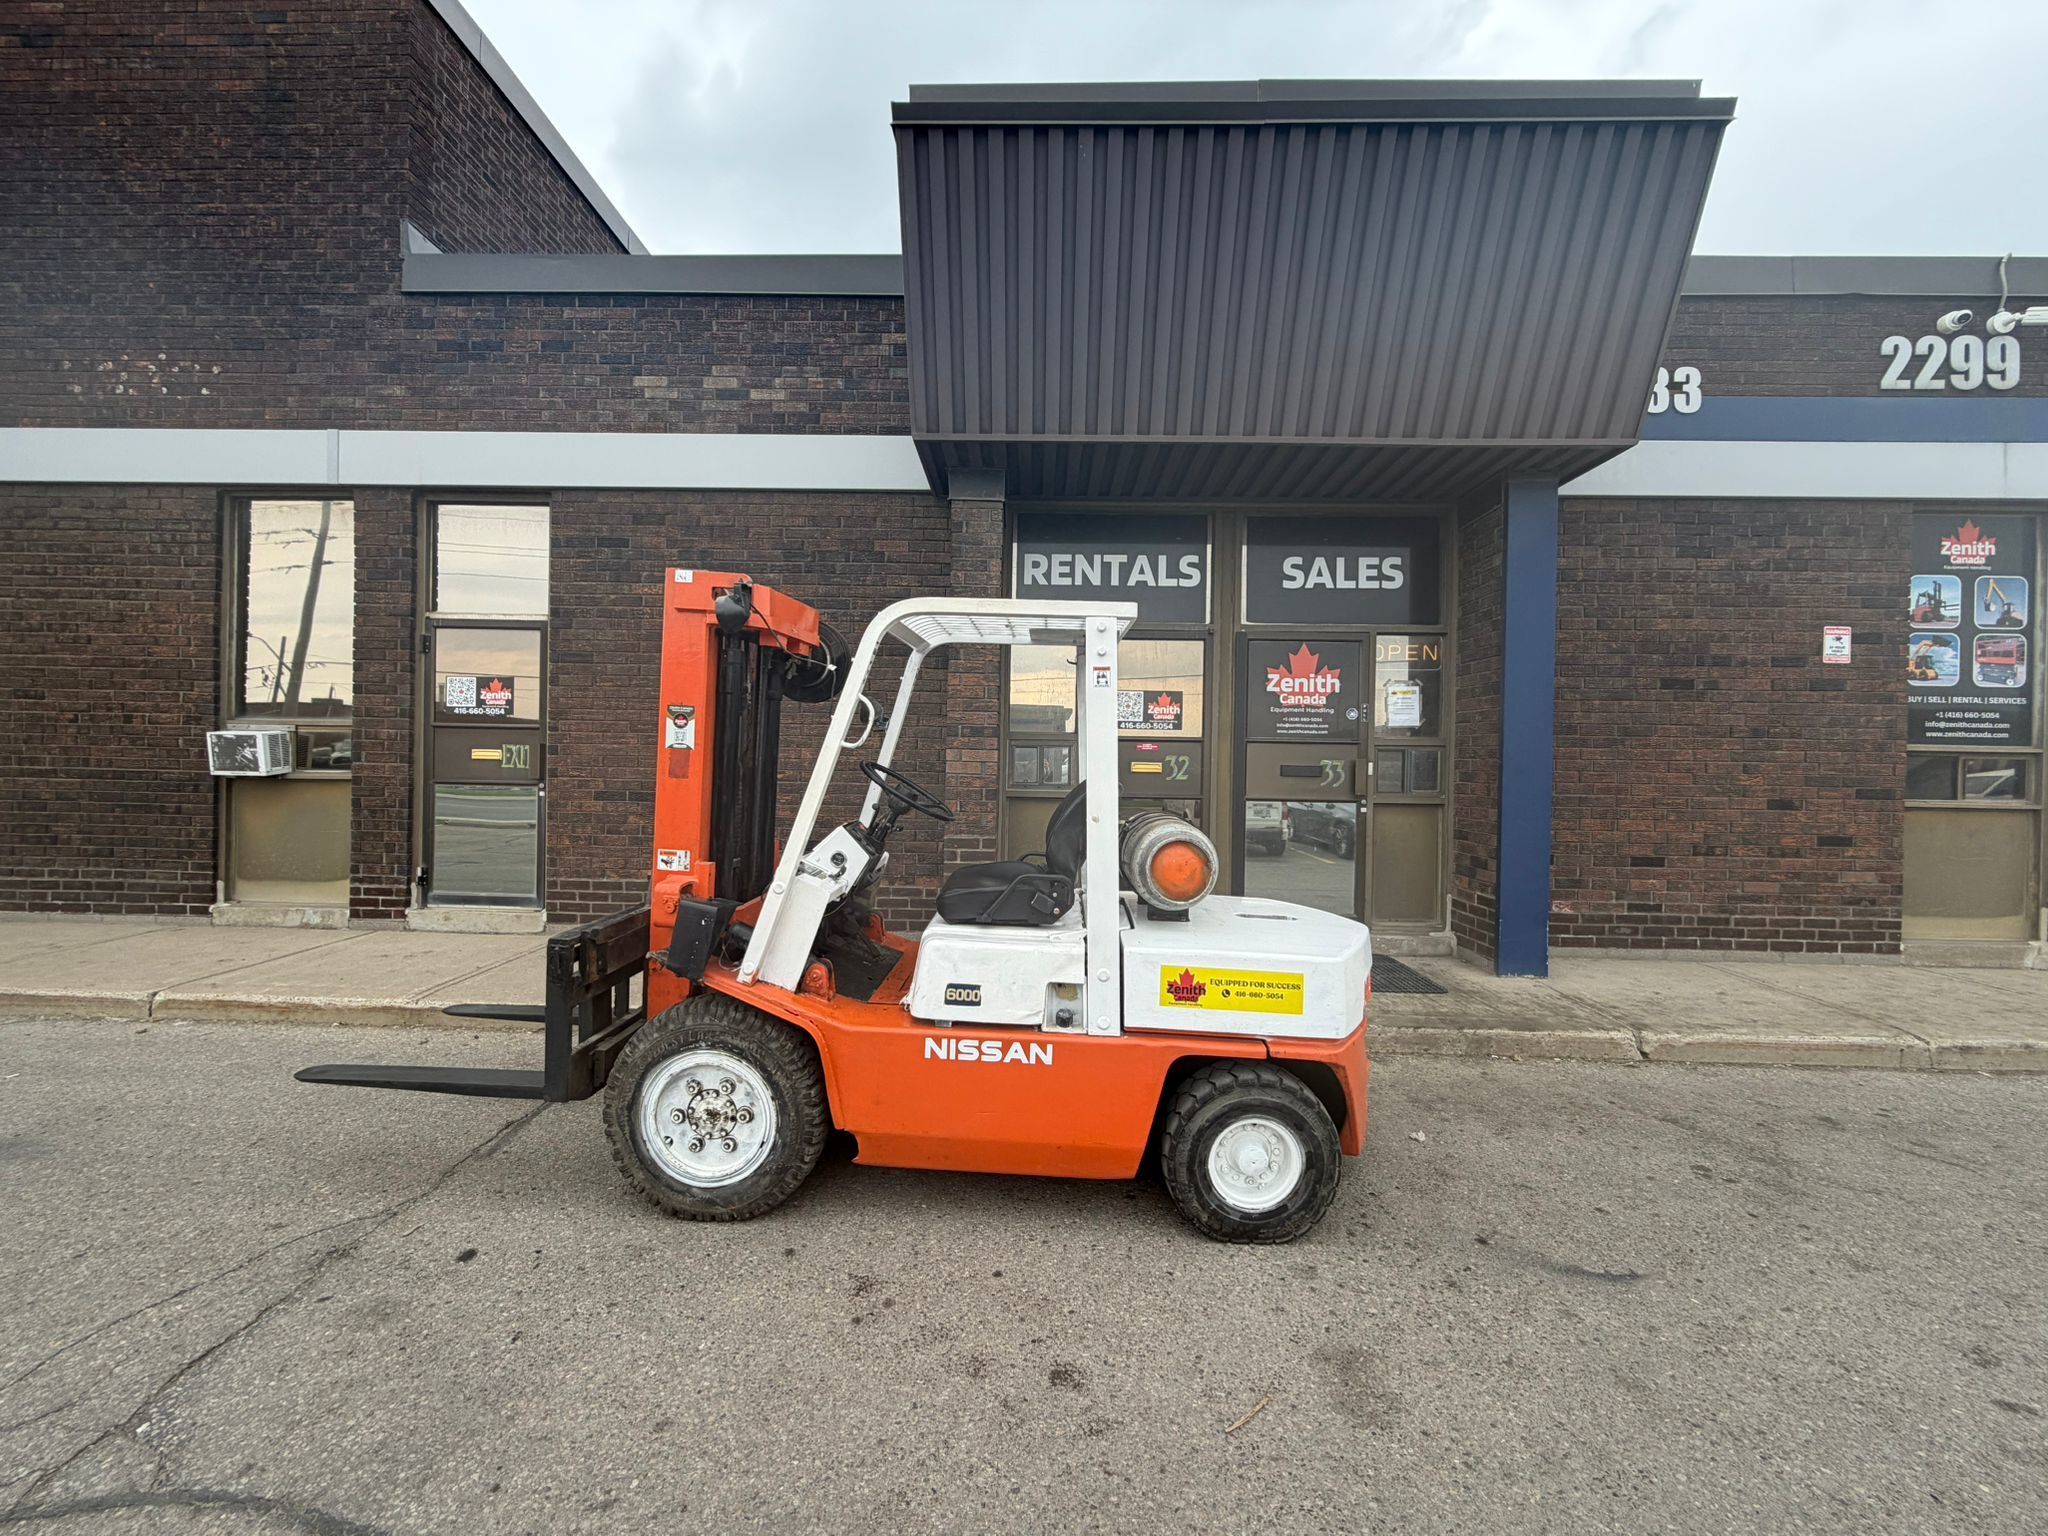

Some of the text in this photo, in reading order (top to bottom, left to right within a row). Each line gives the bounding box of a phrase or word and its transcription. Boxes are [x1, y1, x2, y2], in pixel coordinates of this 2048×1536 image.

[1880, 335, 2020, 390] 2299
[1940, 541, 1996, 555] Zenith
[1950, 555, 1986, 565] Canada
[1023, 553, 1201, 588] RENTALS
[1282, 556, 1404, 589] SALES
[1265, 673, 1341, 693] Zenith
[480, 690, 512, 700] Zenith
[1279, 693, 1327, 705] Canada
[1928, 695, 1947, 703] SELL
[1953, 696, 1983, 704] RENTAL
[1147, 705, 1181, 714] Zenith
[1306, 706, 1335, 714] Handling
[1119, 722, 1173, 730] 416-660-5054
[1925, 721, 2010, 729] info@zenithcanada.com
[1165, 754, 1191, 781] 32
[1319, 759, 1345, 788] 33
[1166, 984, 1206, 996] Zenith
[1210, 978, 1301, 990] EQUIPPED FOR SUCCESS
[946, 988, 981, 1003] 6000
[1173, 995, 1199, 1003] Canada
[1235, 990, 1284, 1000] 416-660-5054
[924, 1037, 1053, 1064] NISSAN
